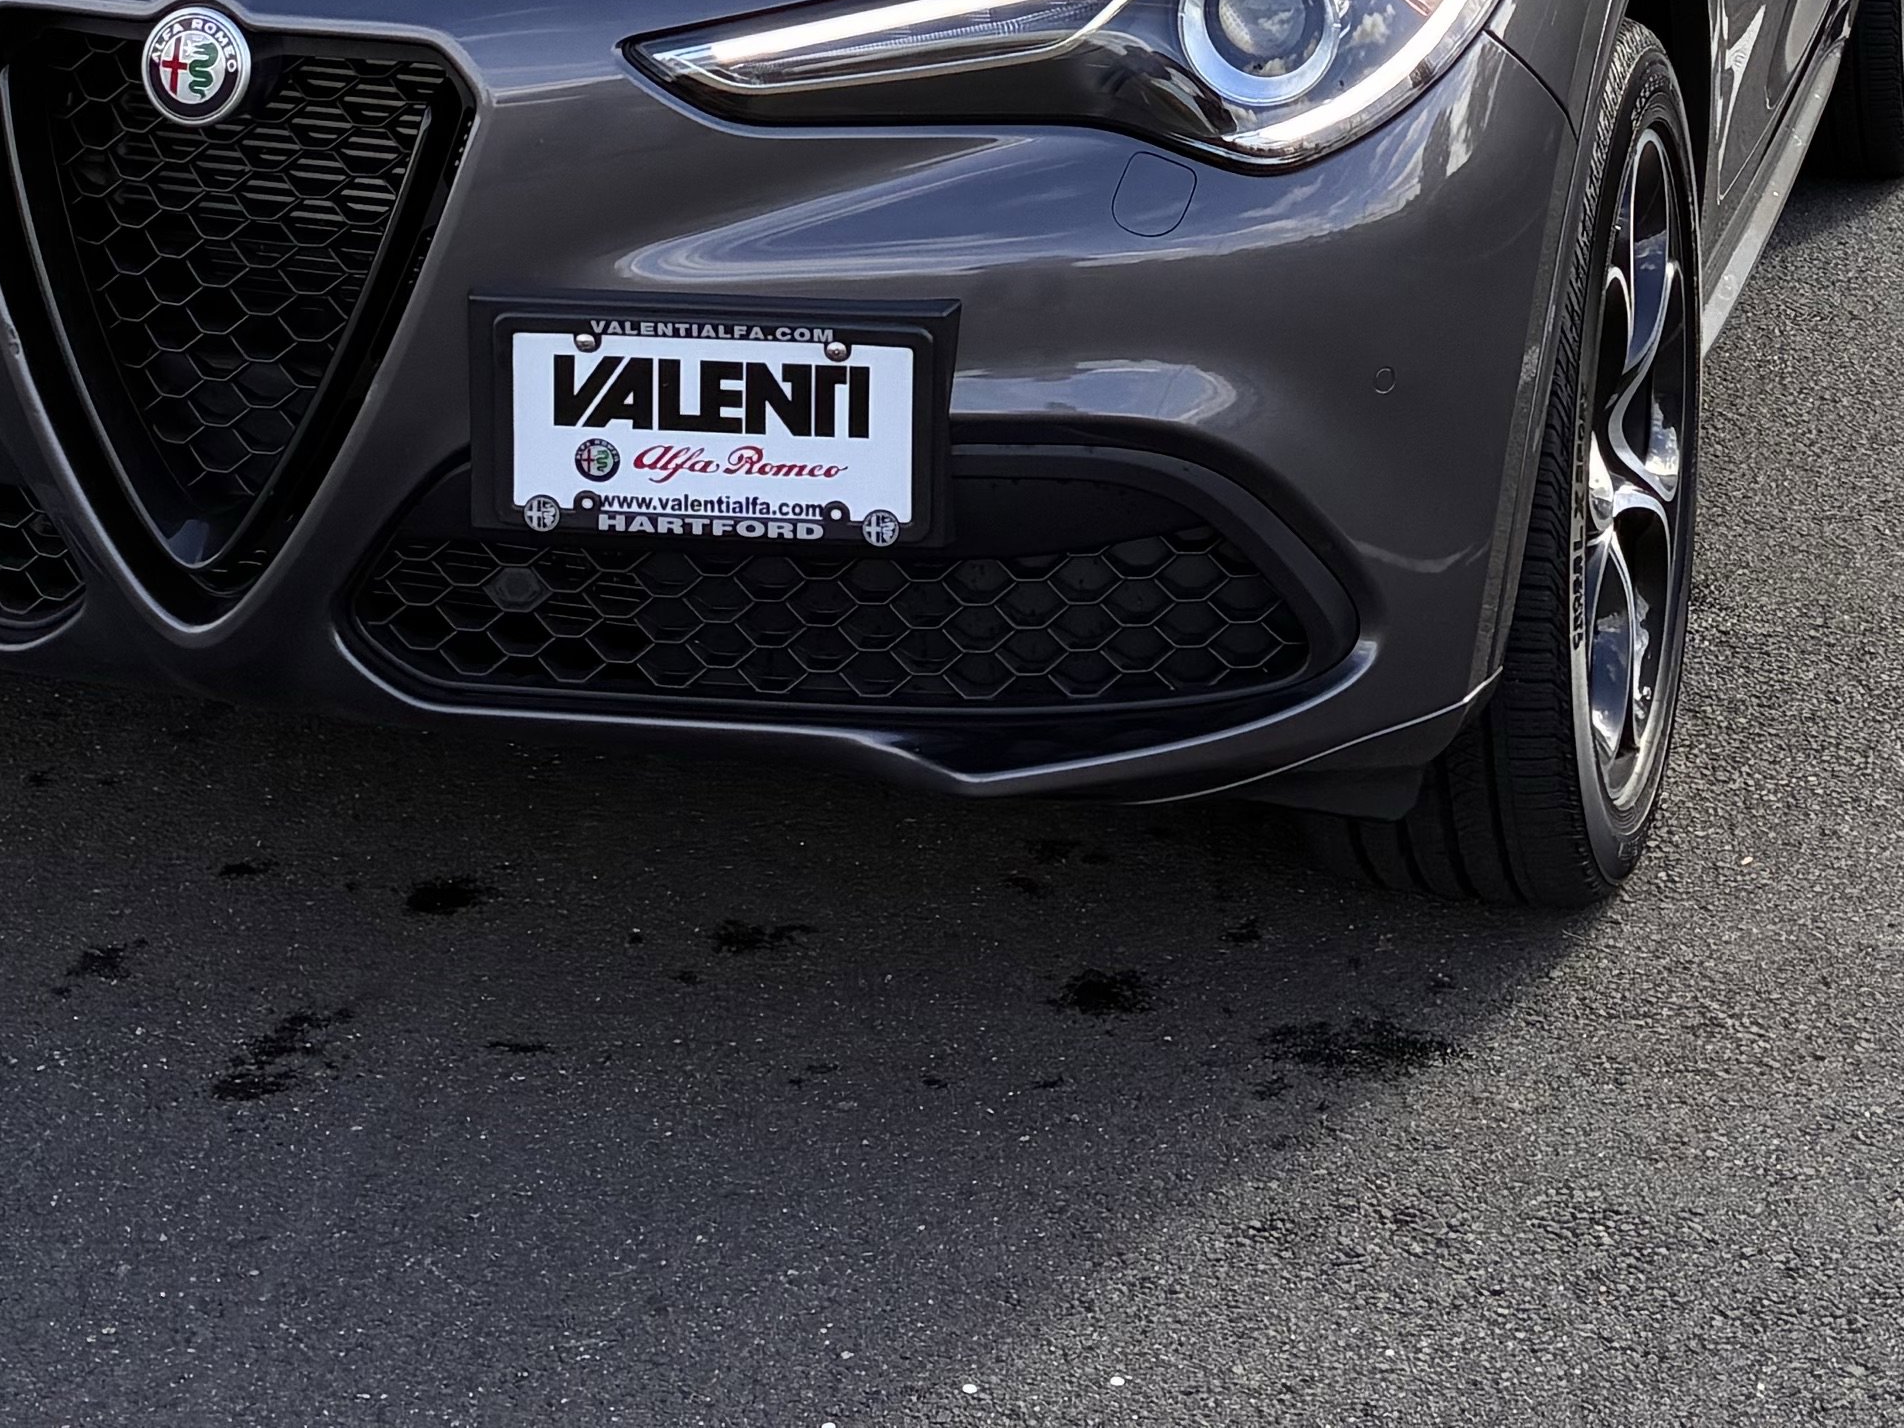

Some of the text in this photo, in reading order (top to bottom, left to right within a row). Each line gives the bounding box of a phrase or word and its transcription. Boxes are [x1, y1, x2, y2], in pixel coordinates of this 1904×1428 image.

[151, 18, 238, 74] ALFA ROMEO
[590, 320, 835, 343] VALENTIALFA.COM
[552, 353, 871, 439] VALENTI
[633, 445, 720, 484] Alfa
[723, 445, 849, 479] Romeo
[599, 493, 825, 519] www.valentialfa.com
[597, 514, 825, 541] HARTFORD
